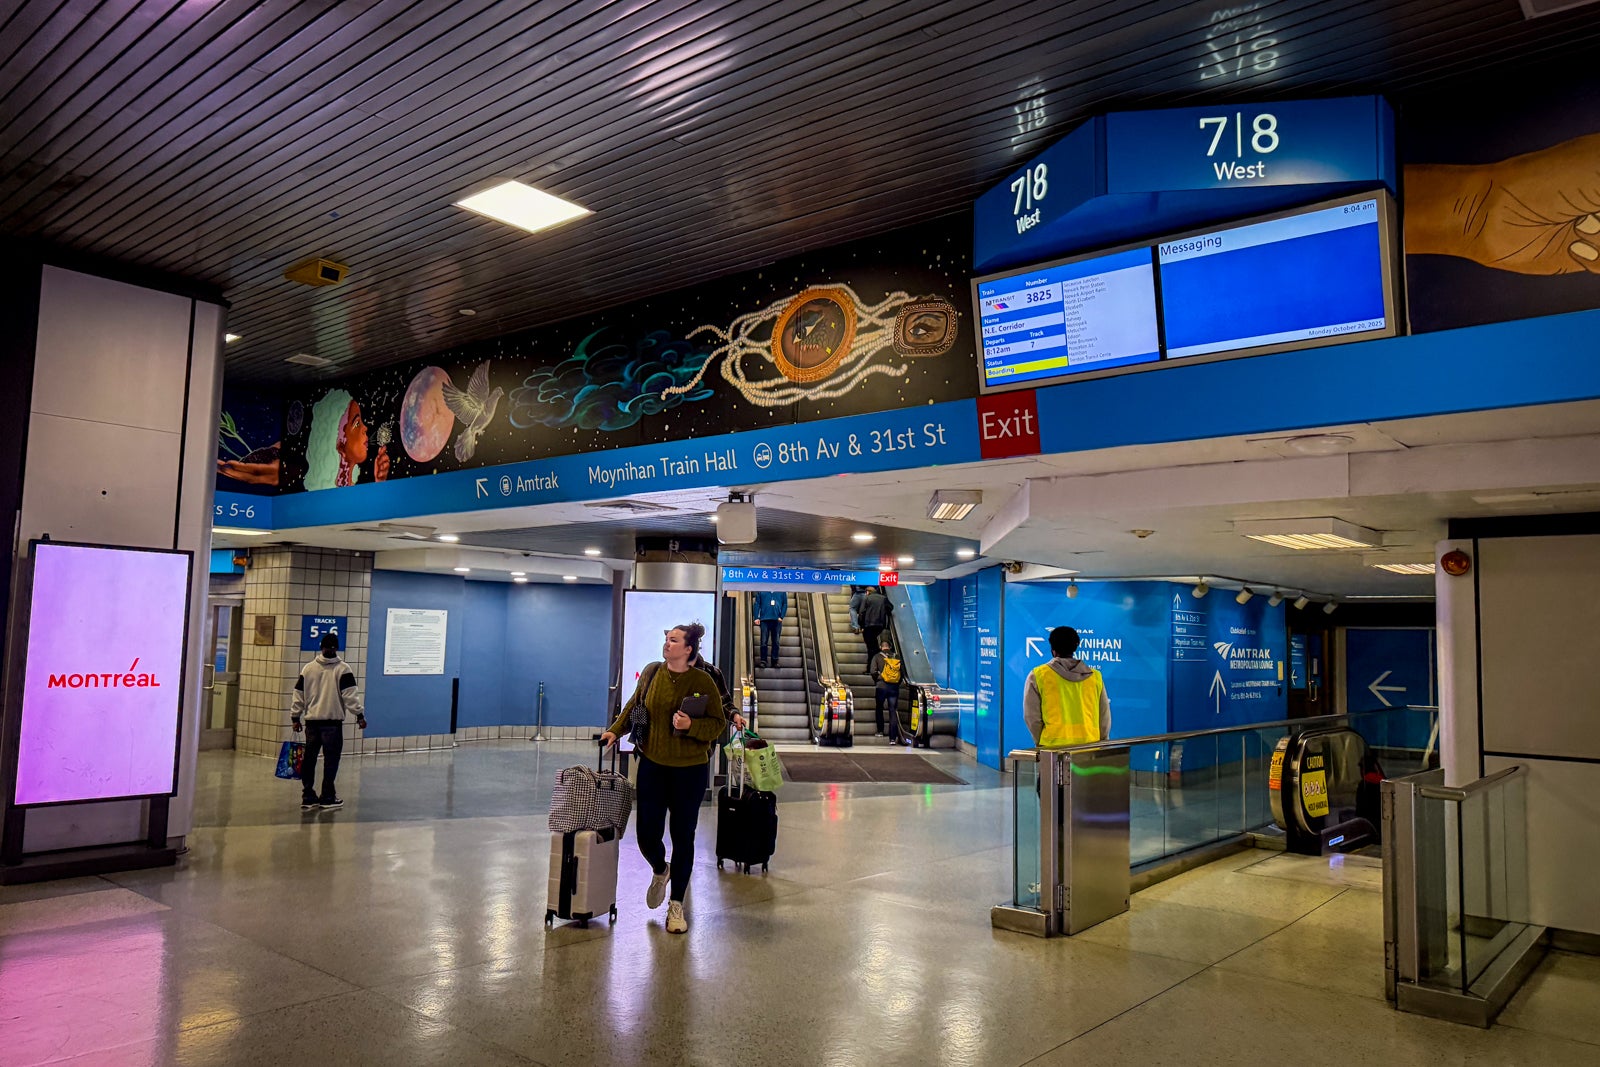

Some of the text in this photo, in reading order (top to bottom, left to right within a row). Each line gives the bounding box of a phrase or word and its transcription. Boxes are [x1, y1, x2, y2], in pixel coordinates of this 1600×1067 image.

[1213, 161, 1265, 180] West
[1343, 204, 1360, 214] 8:04
[1016, 208, 1041, 234] West
[1160, 236, 1222, 256] Messaging
[1025, 278, 1048, 287] Number
[1026, 289, 1052, 303] 3825
[984, 317, 1000, 325] Name
[984, 322, 1025, 335] N.E. Corridor
[1308, 327, 1332, 336] Monday
[1333, 324, 1357, 333] October
[1368, 320, 1383, 328] 2025
[985, 330, 1044, 346] Departs Track
[986, 346, 1011, 356] 8:12am
[988, 366, 1015, 376] Boarding
[981, 408, 1035, 441] Exit
[516, 423, 947, 493] Amtrak Moynihan Train Hall 8th Av & 31st St
[229, 503, 255, 518] 5-6
[728, 571, 856, 582] 8th Av & 31st St Amtrak
[880, 573, 897, 583] Exit
[1079, 638, 1122, 650] YNIHAN
[1072, 651, 1122, 662] AIN HALL
[1230, 648, 1271, 659] AMTRAK
[1230, 660, 1259, 670] METROPOLITAN
